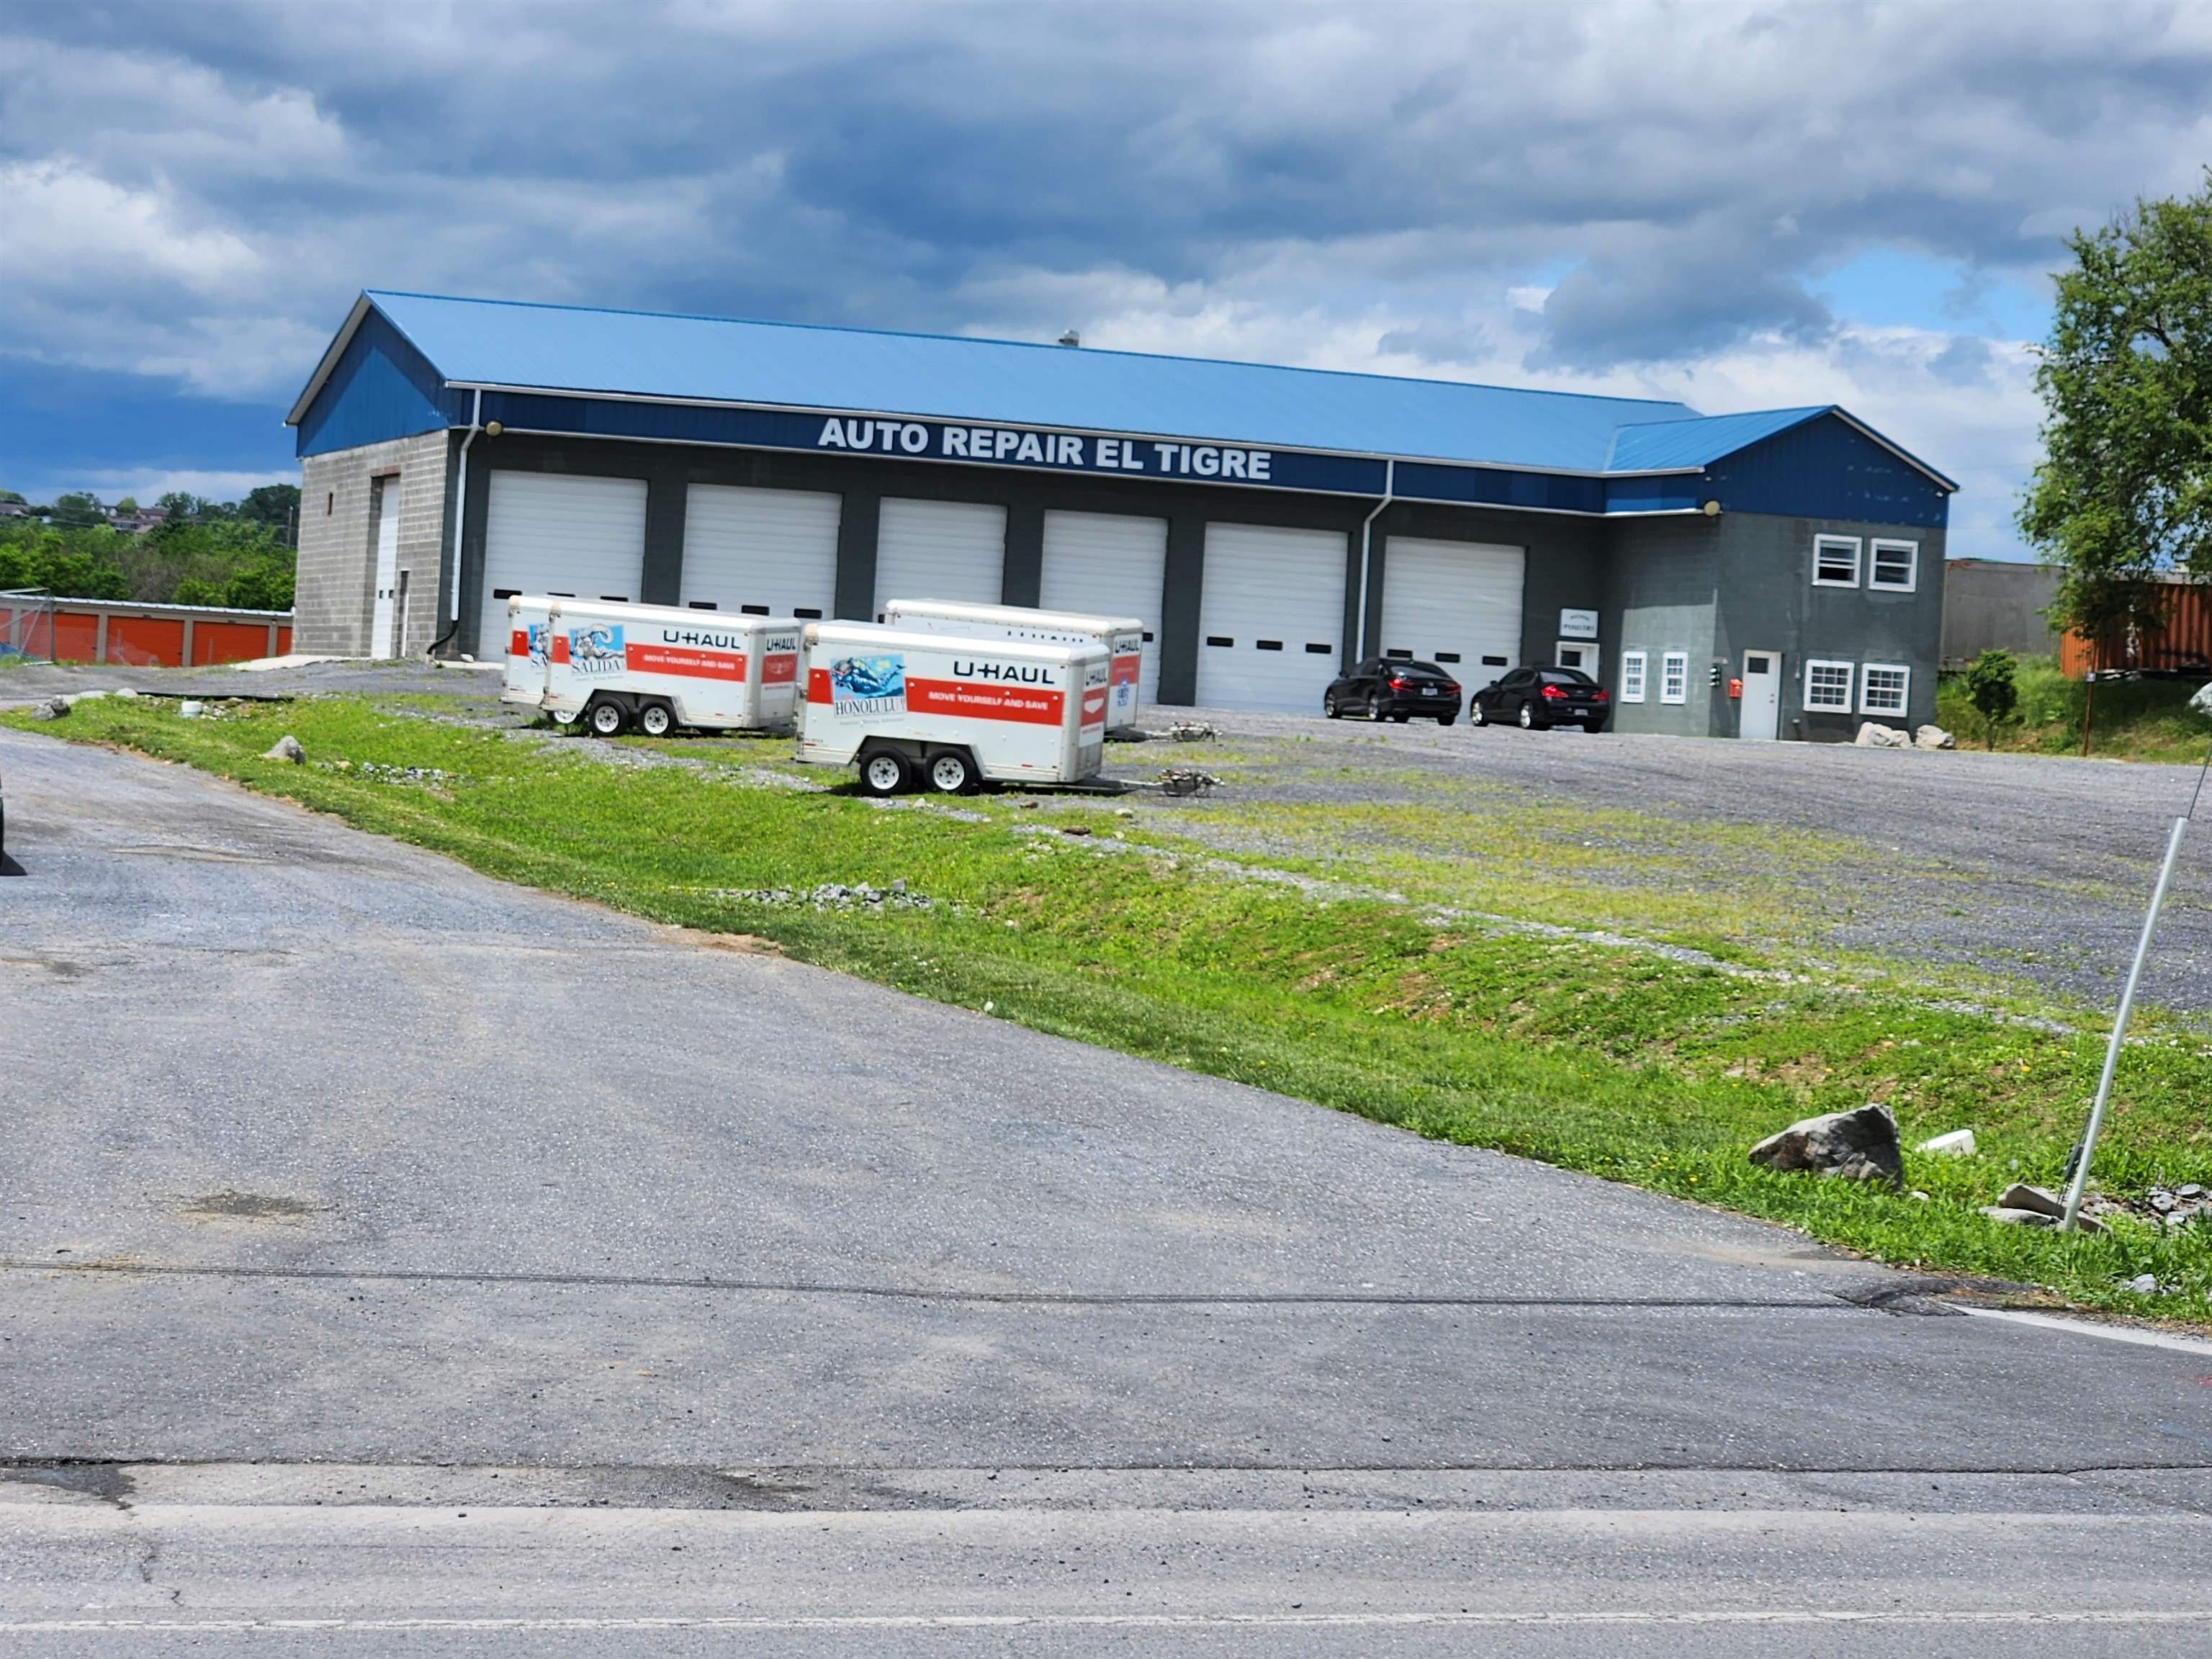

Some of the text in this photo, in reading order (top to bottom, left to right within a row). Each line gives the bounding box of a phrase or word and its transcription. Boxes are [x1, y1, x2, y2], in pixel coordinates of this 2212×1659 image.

[818, 418, 1272, 480] AUTO REPAIR EL TIGRE
[571, 658, 621, 674] SALIDA
[666, 656, 701, 667] YOURSELF
[701, 660, 717, 668] AND
[717, 661, 736, 670] SAVE
[835, 698, 899, 716] HONOLULU
[928, 691, 1049, 711] MOVE YOURSELF AND SAVE
